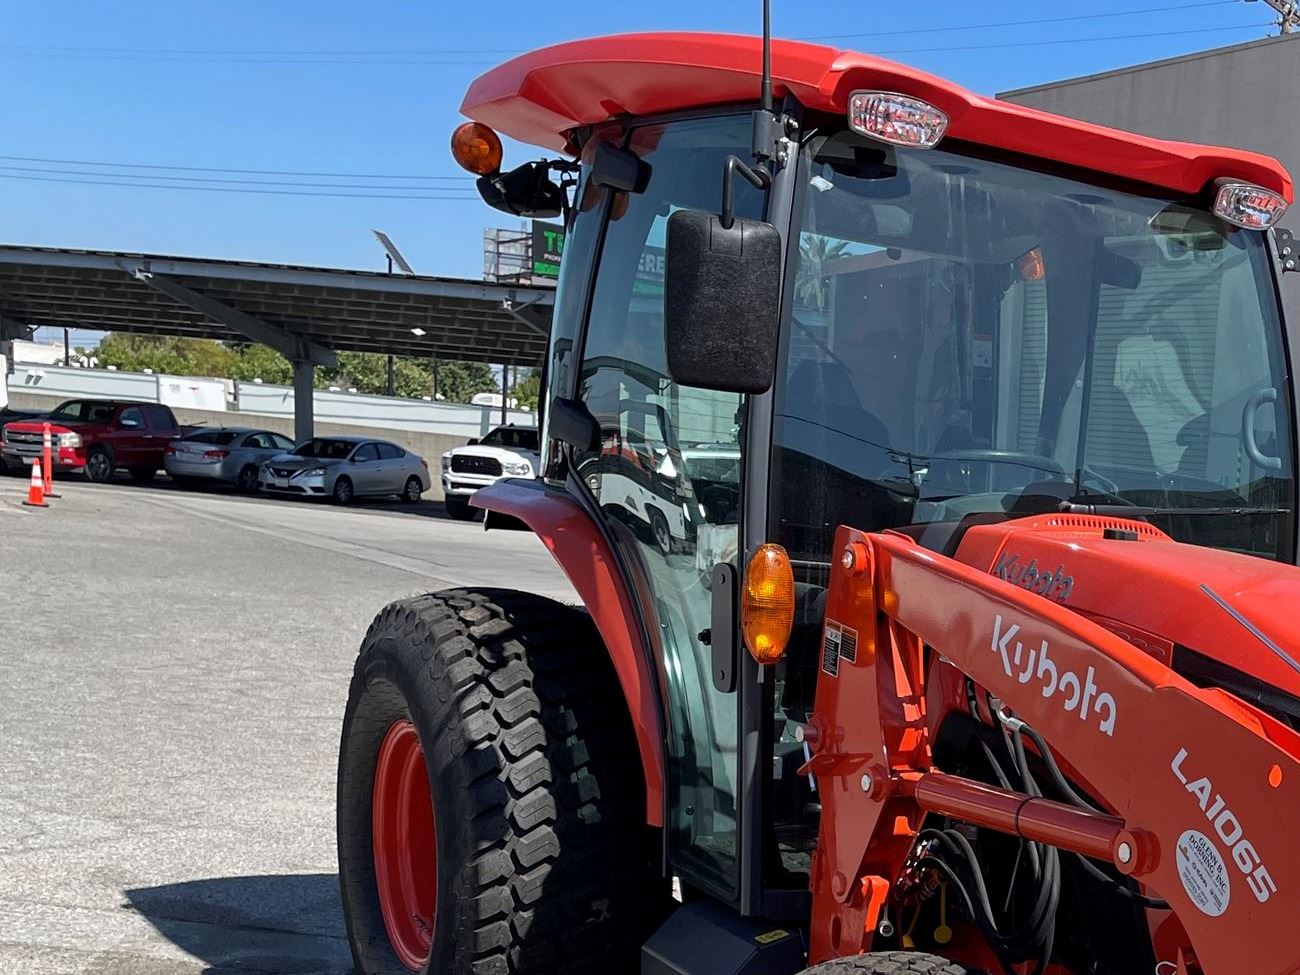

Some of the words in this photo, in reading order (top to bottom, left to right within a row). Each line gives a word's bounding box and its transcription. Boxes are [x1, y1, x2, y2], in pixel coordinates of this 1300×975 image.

[995, 551, 1074, 600] Kubota
[990, 614, 1117, 737] Kubota
[1171, 747, 1277, 903] LA1065
